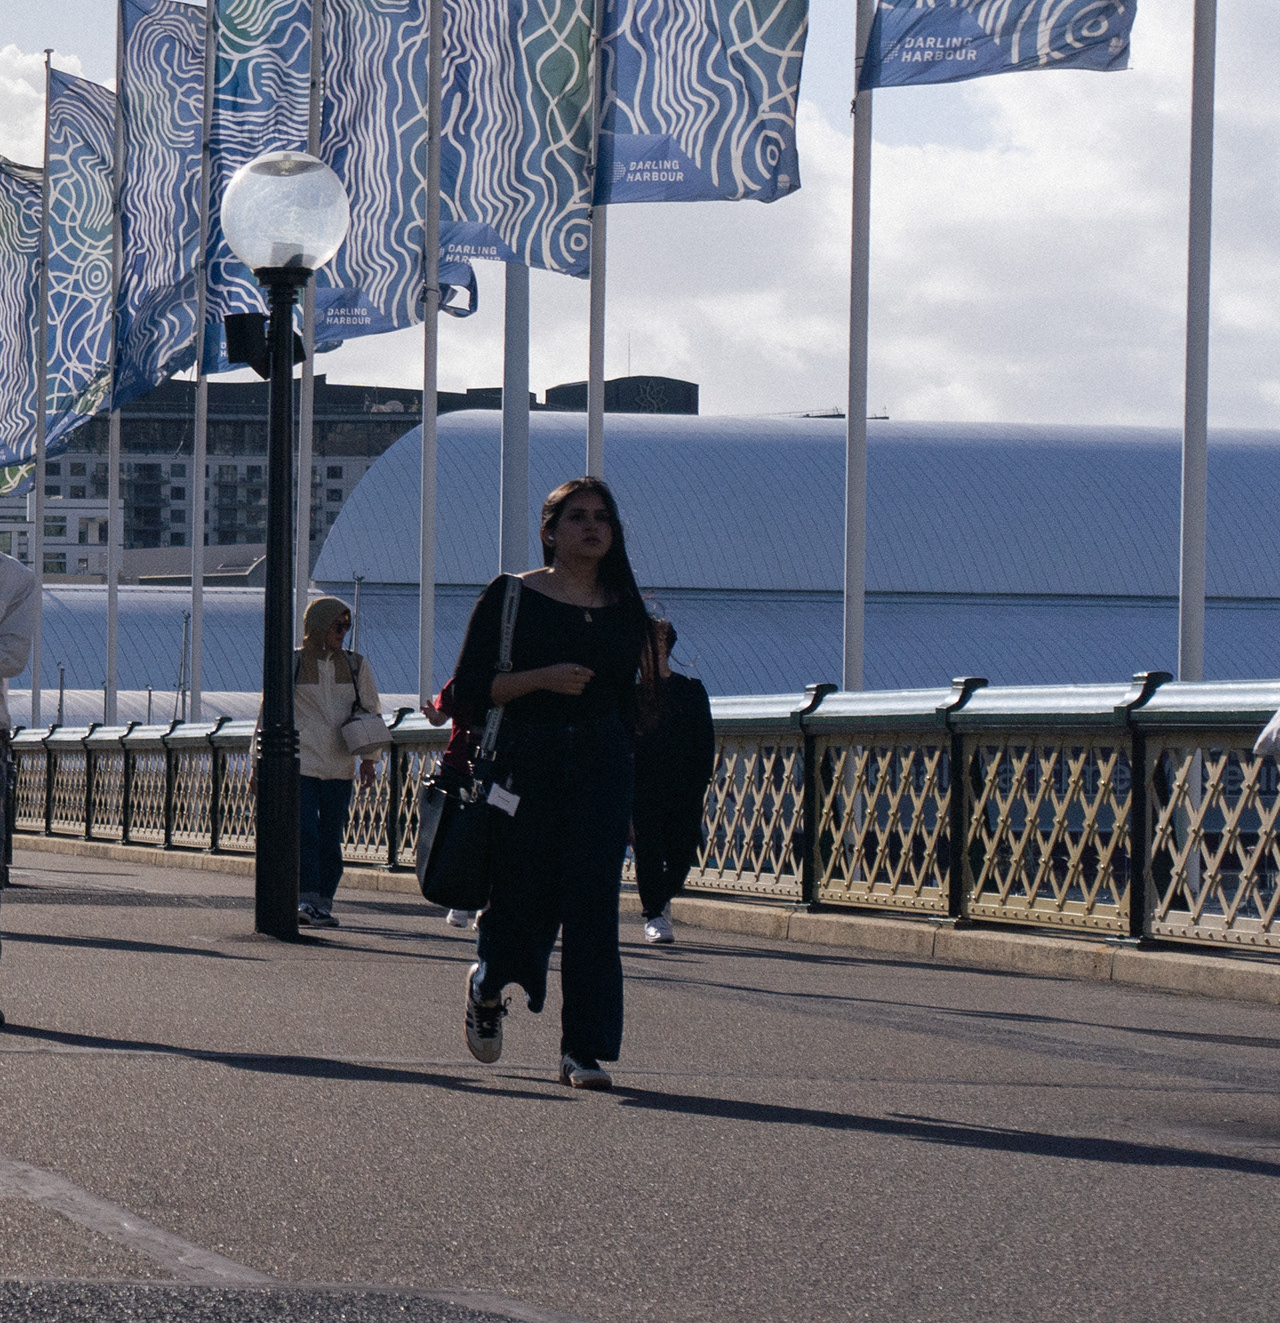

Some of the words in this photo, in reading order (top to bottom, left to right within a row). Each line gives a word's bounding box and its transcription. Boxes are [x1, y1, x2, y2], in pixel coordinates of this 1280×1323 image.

[901, 49, 978, 63] HARBOUR
[630, 160, 680, 171] DARLING
[626, 171, 685, 182] HARBOUR
[448, 244, 498, 255] DARLING
[327, 308, 369, 316] DARLING
[326, 316, 372, 326] HARBOUR
